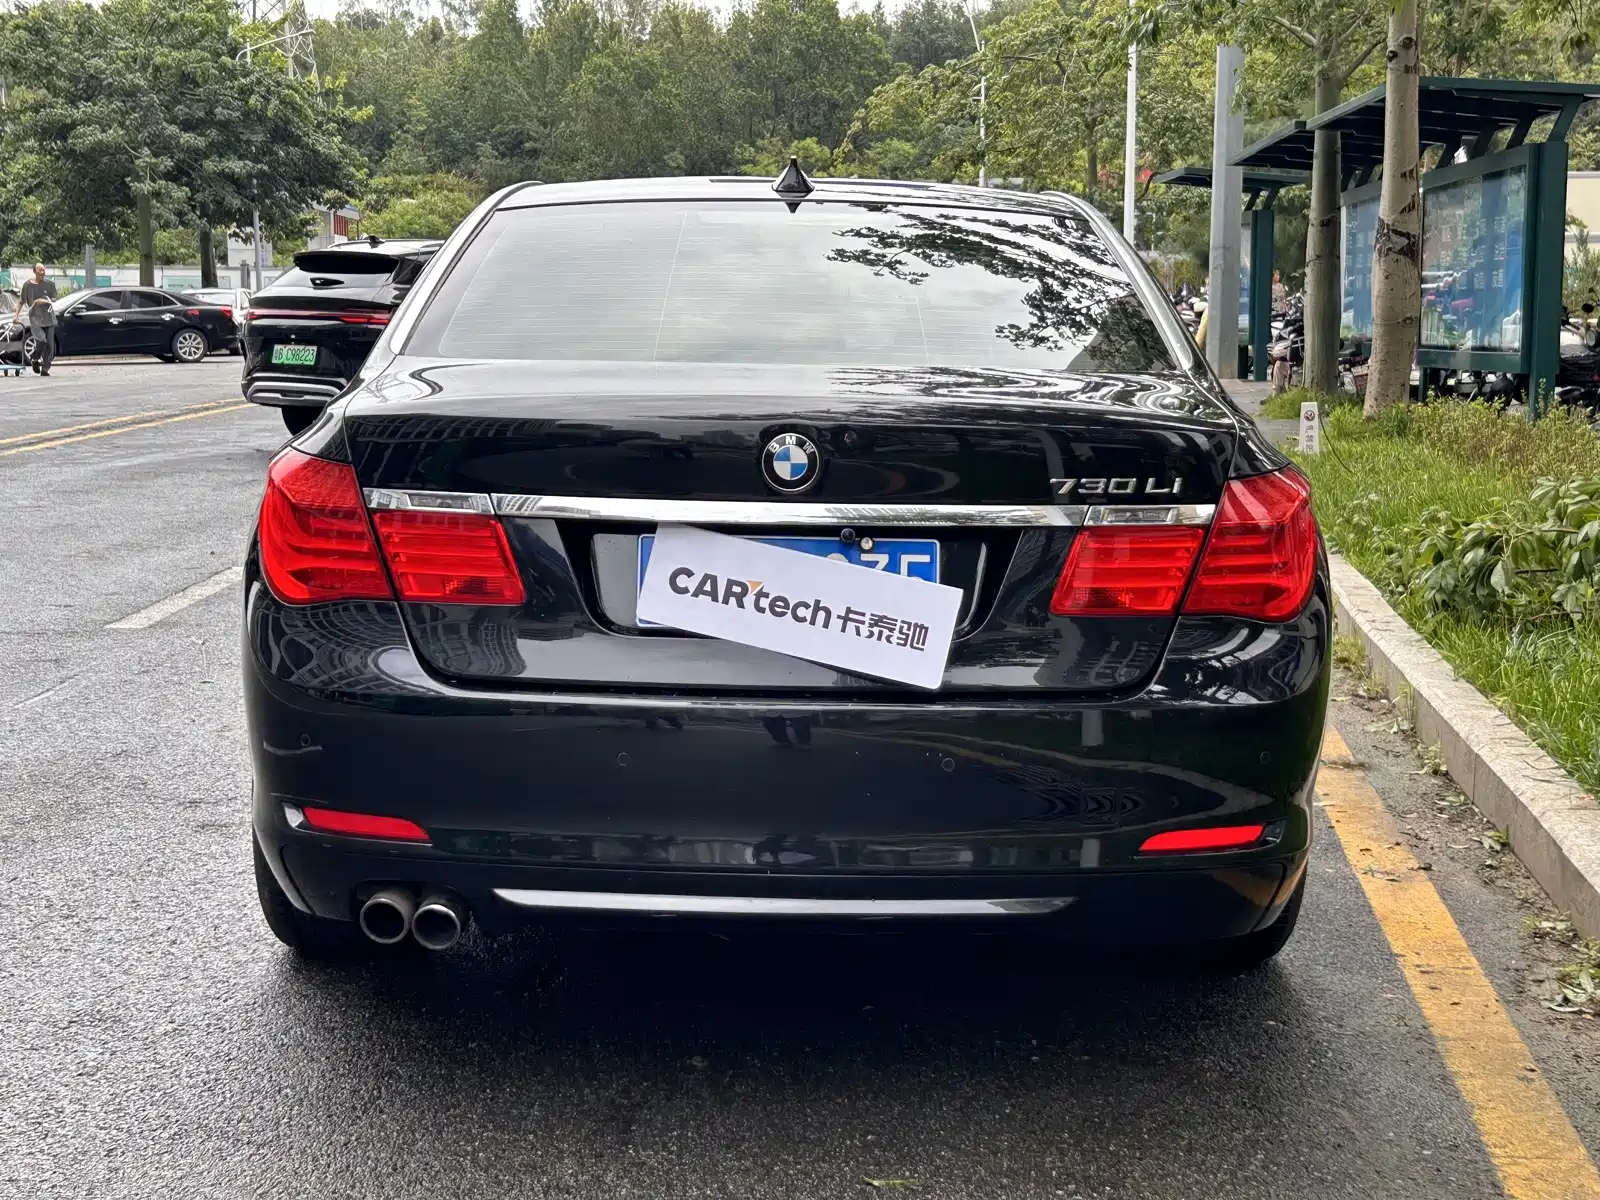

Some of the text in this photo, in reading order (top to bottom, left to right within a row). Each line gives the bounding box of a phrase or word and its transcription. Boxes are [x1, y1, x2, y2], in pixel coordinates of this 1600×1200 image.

[768, 435, 815, 455] BMW
[1049, 477, 1183, 494] 730 Li
[668, 566, 832, 630] CARtech
[836, 605, 930, 652] 卡泰驰
